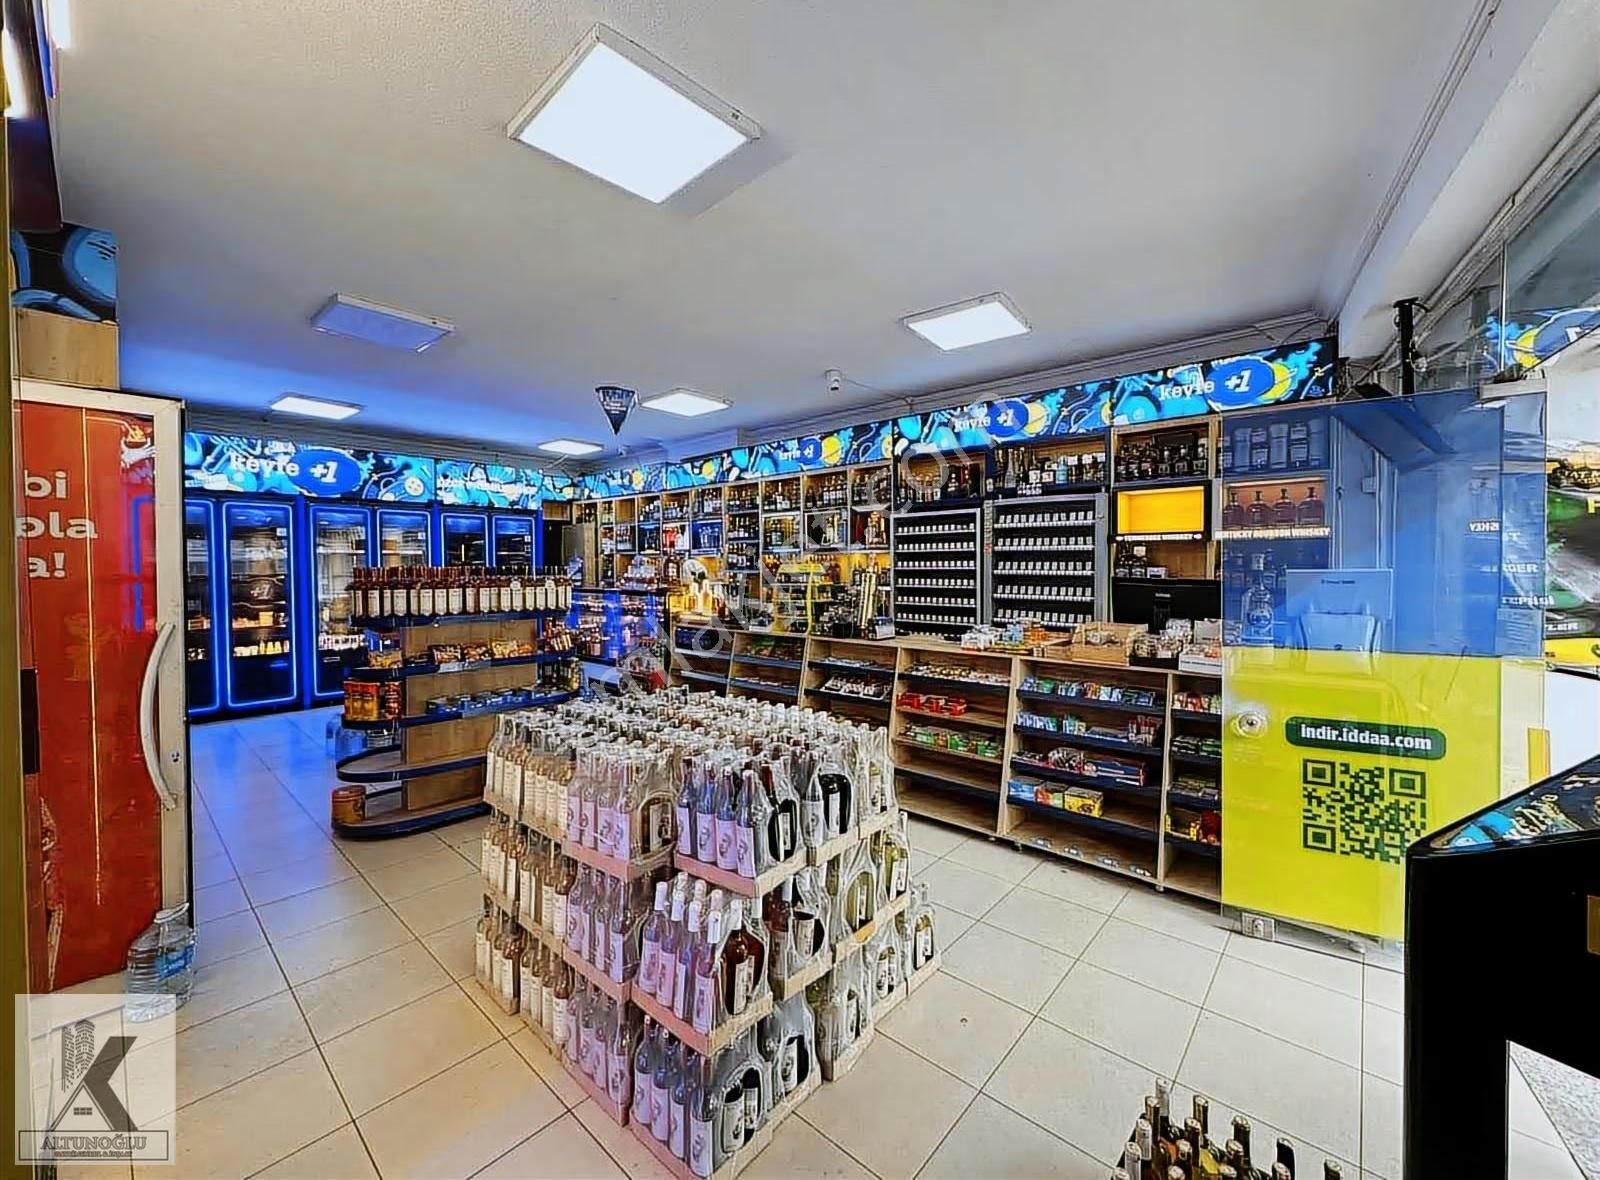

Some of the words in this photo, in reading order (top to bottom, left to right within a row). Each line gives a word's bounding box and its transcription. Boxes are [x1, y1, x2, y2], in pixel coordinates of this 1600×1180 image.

[1224, 369, 1252, 393] +1
[309, 461, 338, 483] +1
[1301, 724, 1432, 750] indir.iddaa.com
